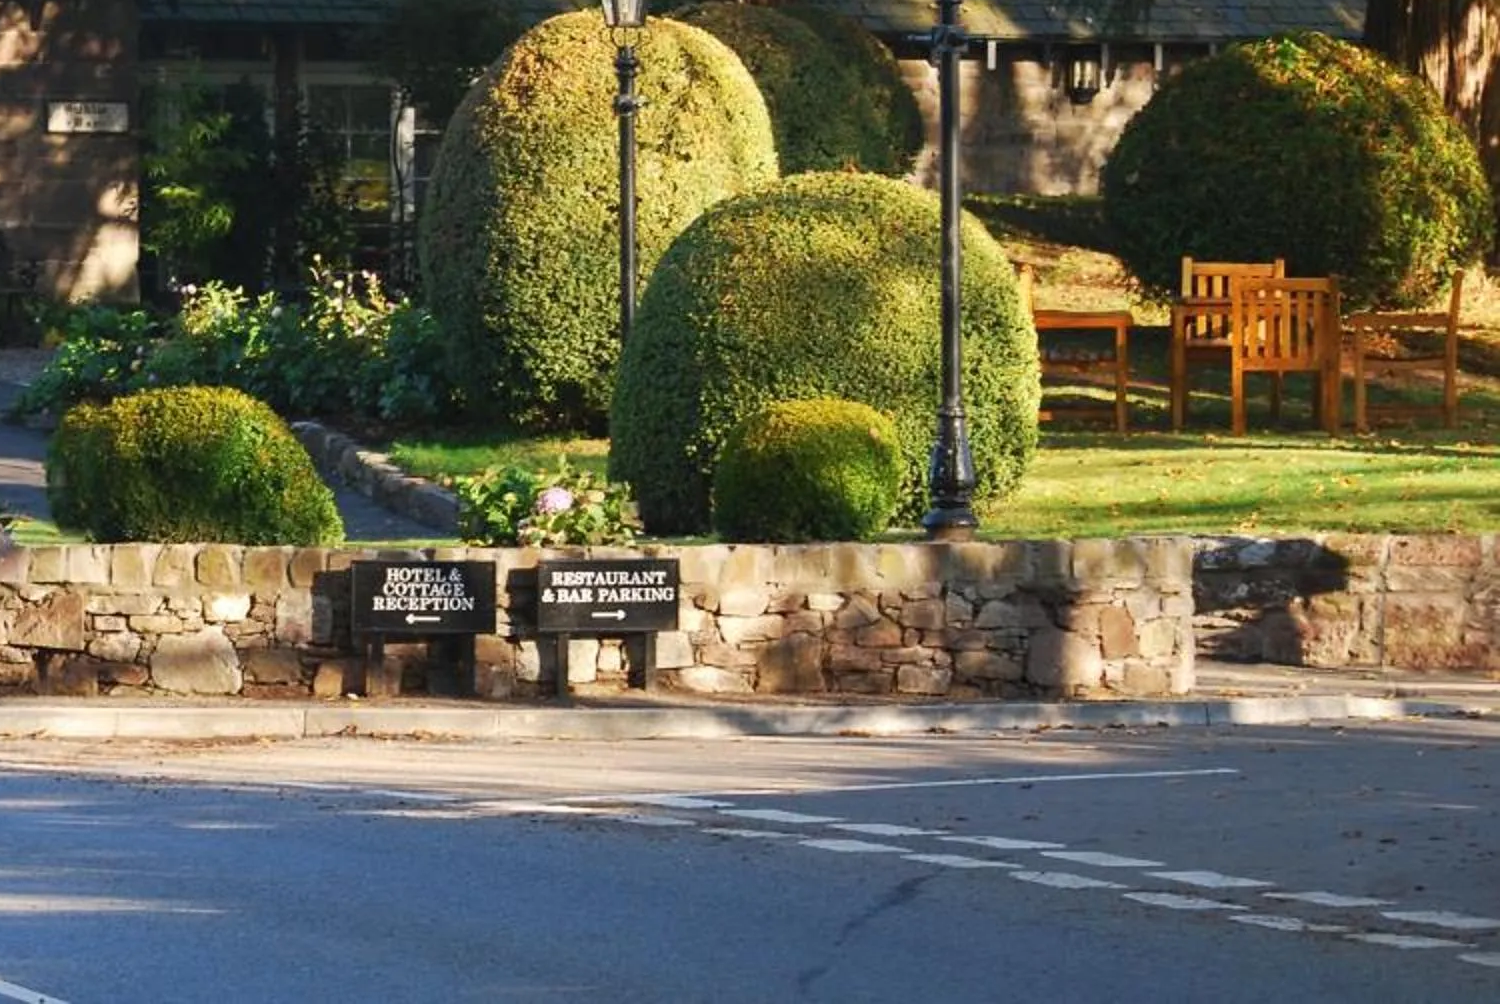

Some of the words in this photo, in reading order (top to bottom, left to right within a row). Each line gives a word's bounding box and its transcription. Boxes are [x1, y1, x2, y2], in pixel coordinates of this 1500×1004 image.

[386, 567, 446, 583] HOTEL
[449, 567, 463, 582] &
[551, 571, 667, 586] RESTAURANT
[383, 582, 465, 597] COTTAGE
[541, 588, 555, 603] &
[557, 588, 593, 603] BAR
[598, 587, 675, 602] PARKING
[372, 596, 475, 611] RECEPTION
